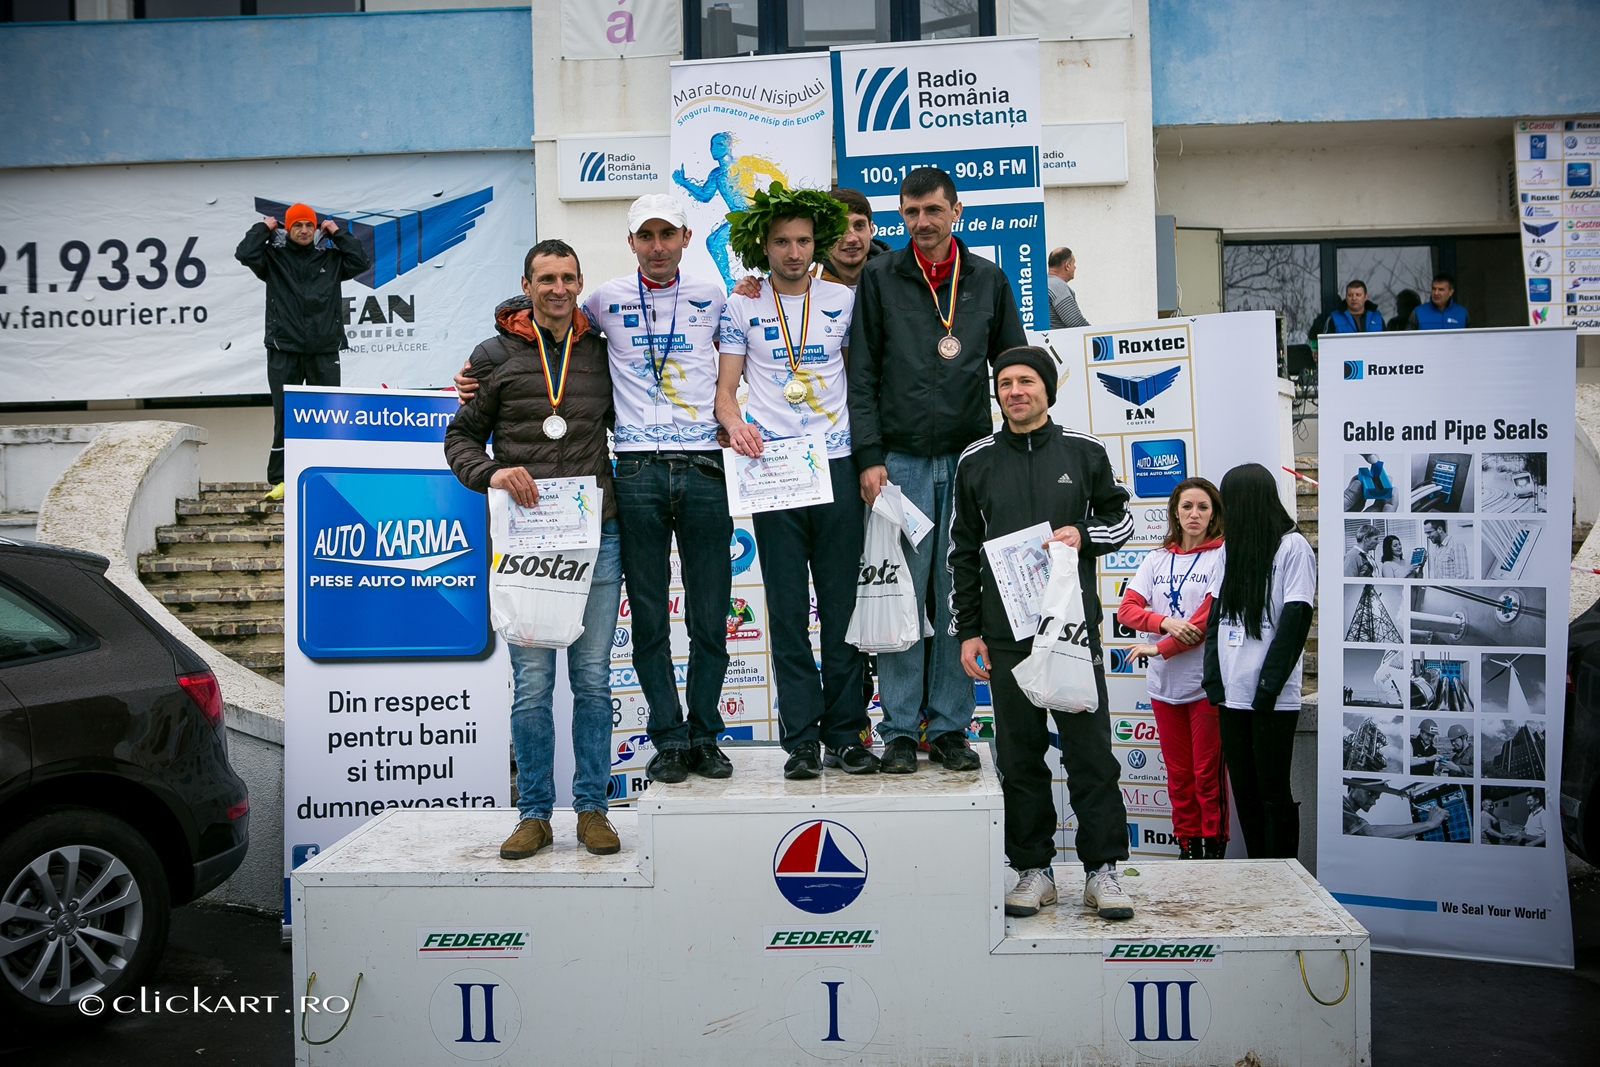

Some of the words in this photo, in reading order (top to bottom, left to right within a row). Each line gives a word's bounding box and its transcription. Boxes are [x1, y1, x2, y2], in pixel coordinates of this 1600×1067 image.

[917, 68, 978, 89] Radio
[673, 80, 758, 107] Maratonul
[760, 77, 826, 108] Nisipului
[918, 86, 1010, 109] România
[677, 104, 711, 127] Singurul
[713, 104, 749, 119] maraton
[749, 112, 760, 123] pe
[760, 115, 781, 128] nisip
[782, 116, 795, 127] din
[796, 109, 826, 127] Europa
[918, 106, 1028, 129] Constanța
[1528, 121, 1556, 130] Castrol
[607, 153, 636, 163] Radio
[1042, 150, 1064, 160] adio
[607, 162, 651, 172] România
[860, 165, 907, 185] 100,1
[955, 160, 994, 180] 90,8
[999, 158, 1027, 176] FM
[607, 171, 658, 182] Constanța
[968, 217, 987, 232] de
[991, 216, 1005, 231] la
[1008, 214, 1038, 230] noi!
[341, 294, 415, 325] FAN
[621, 303, 652, 311] Roxtc
[346, 326, 415, 339] ourier
[634, 335, 684, 345] Maatoul
[371, 344, 383, 353] CU
[386, 341, 431, 353] PLĂCERE.
[1118, 336, 1186, 355] Roxtec
[1367, 363, 1424, 376] Roxtec
[1125, 407, 1155, 421] FAN
[1343, 420, 1395, 442] Cable
[1401, 420, 1437, 442] and
[1444, 419, 1487, 445] Pipe
[1493, 418, 1549, 441] Seals
[1136, 456, 1152, 469] AUTO
[1153, 453, 1180, 467] KARMA
[313, 522, 366, 558] AUTO
[375, 519, 469, 558] KARMA
[309, 575, 353, 587] PIESE
[358, 575, 406, 587] AUTO
[411, 574, 477, 587] IMPORT
[328, 690, 367, 714] Din
[373, 689, 471, 717] respect
[328, 725, 413, 754] pentru
[419, 721, 477, 745] banii
[347, 759, 367, 783] si
[374, 755, 454, 786] timpul
[1128, 773, 1161, 781] Cardinal
[1122, 787, 1149, 806] Mr
[1441, 901, 1459, 914] We
[1461, 902, 1484, 916] Seal
[1488, 904, 1512, 918] Your
[424, 931, 527, 948] FEDERAL
[770, 929, 876, 945] FEDERAL
[1109, 943, 1217, 959] FEDERAL
[453, 983, 501, 1043] II
[820, 981, 846, 1042] I
[1127, 980, 1200, 1043] III
